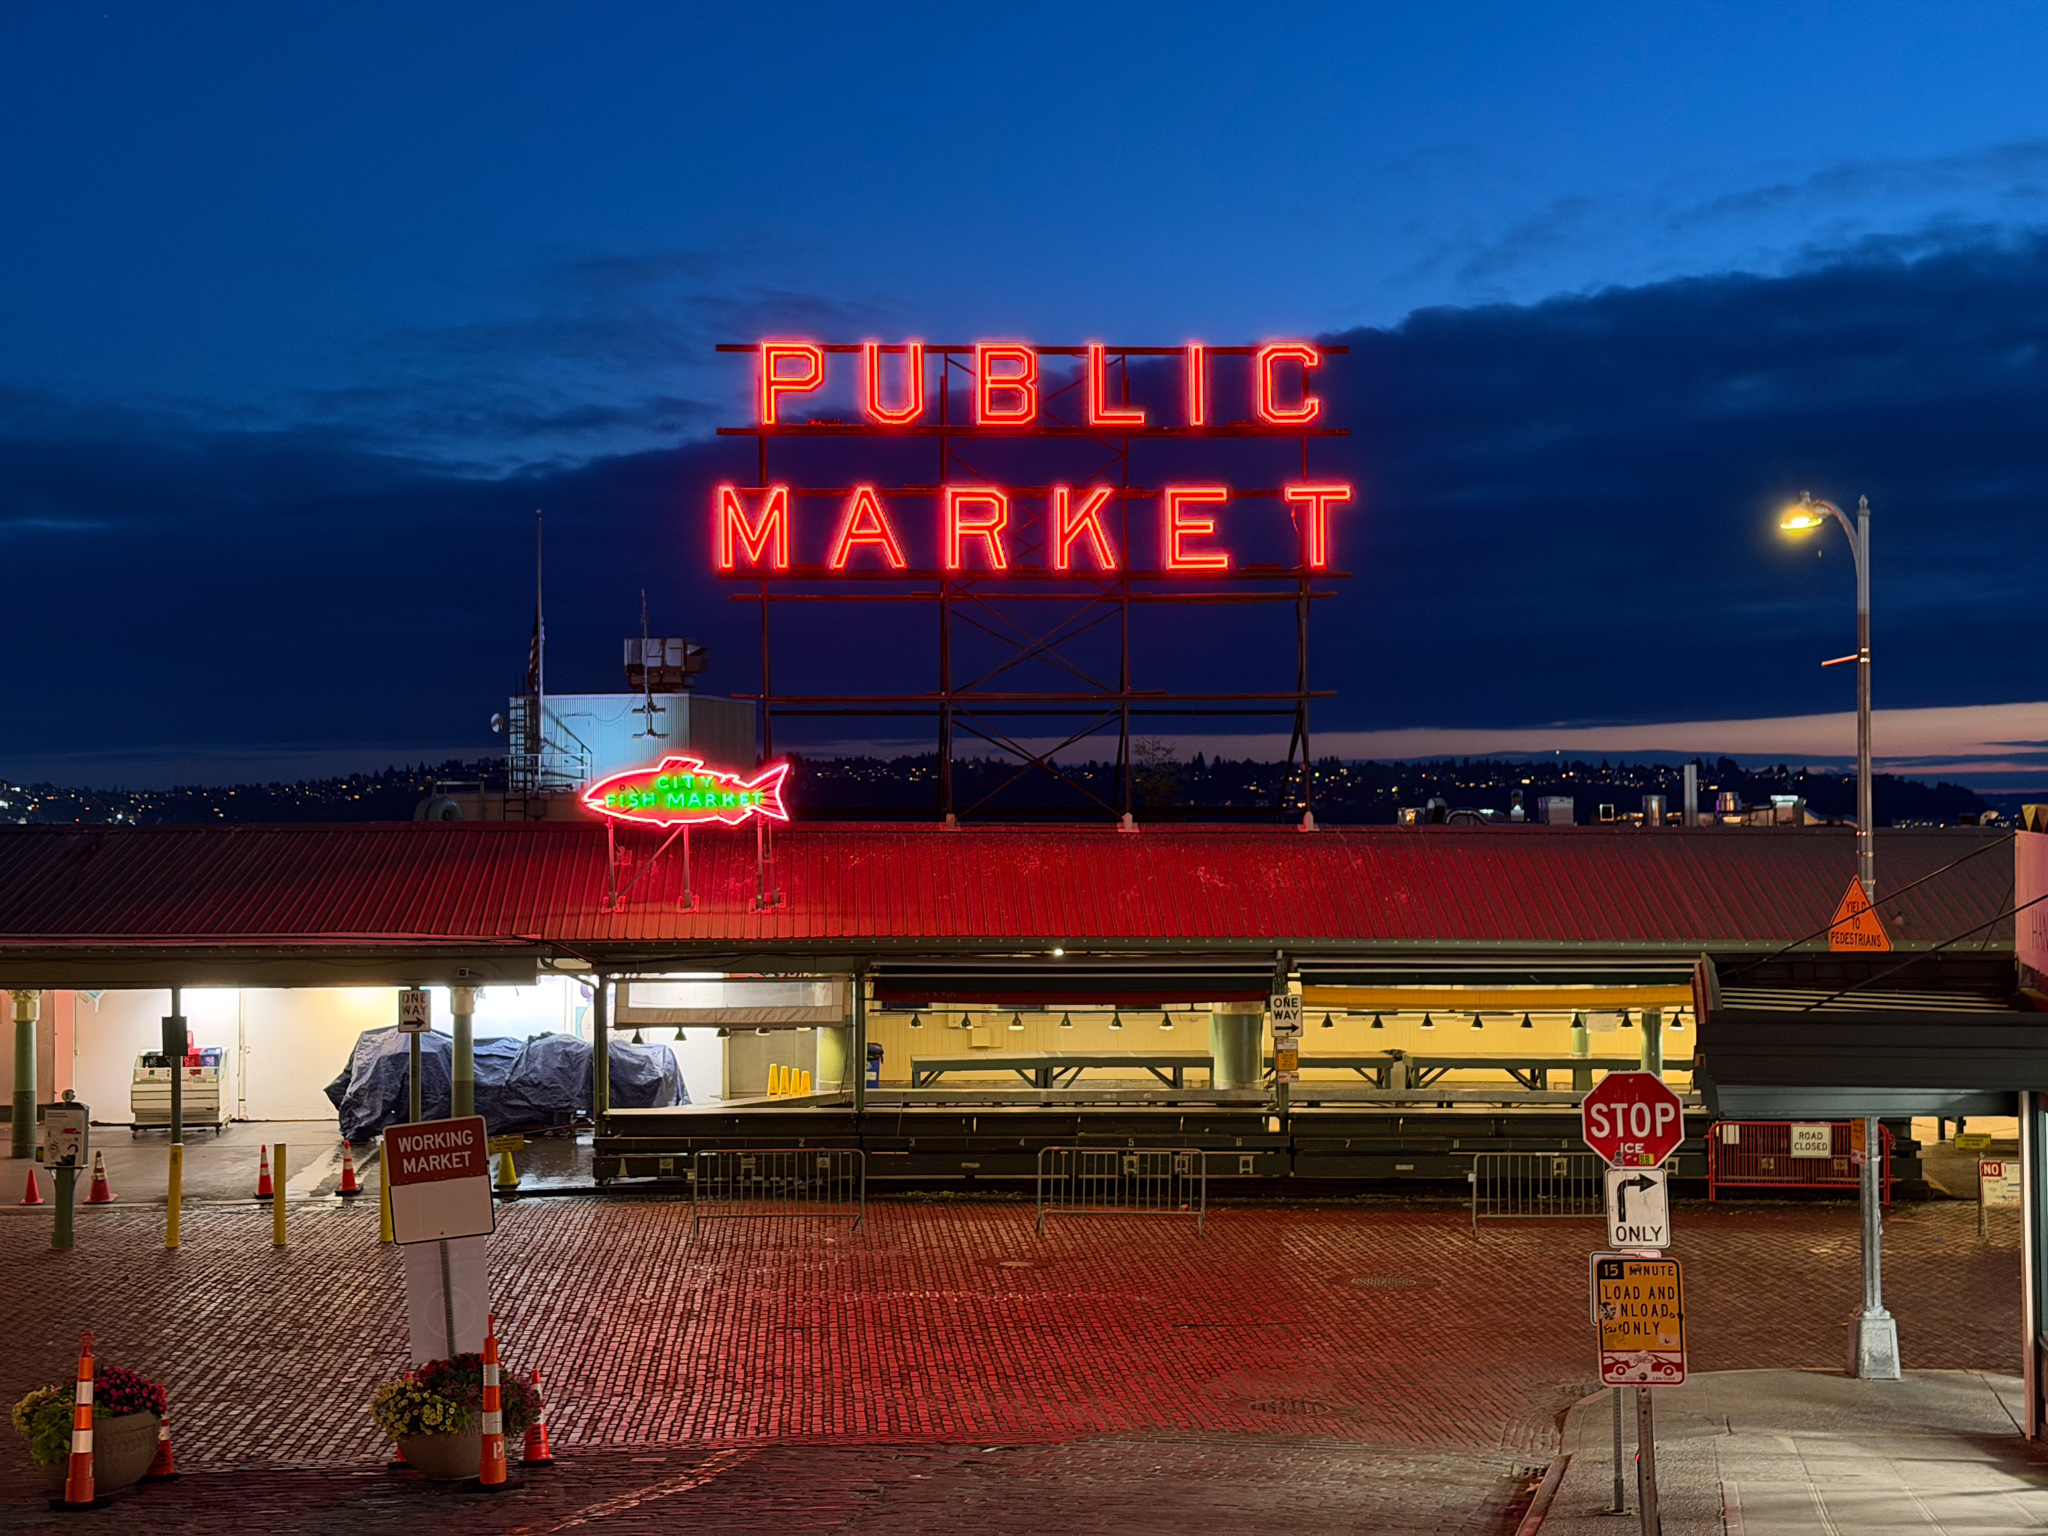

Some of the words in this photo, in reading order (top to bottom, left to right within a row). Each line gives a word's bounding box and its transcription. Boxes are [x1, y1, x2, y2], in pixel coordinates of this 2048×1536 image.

[760, 340, 1321, 426] PUBLIC
[717, 485, 1353, 570] MARKET
[656, 774, 714, 789] CITY
[604, 793, 656, 808] FISH
[666, 792, 765, 808] MARKET
[1846, 900, 1867, 913] YIELD
[1852, 916, 1860, 930] TO
[1830, 931, 1882, 947] PEDESTRIANS
[1273, 997, 1299, 1008] ONE
[402, 1004, 427, 1016] WAY
[1273, 1009, 1299, 1020] WAY
[1590, 1102, 1675, 1138] STOP
[397, 1129, 474, 1153] WORKING
[1799, 1131, 1823, 1140] ROAD
[1620, 1142, 1645, 1154] ICE
[1794, 1142, 1828, 1151] CLOSED
[403, 1151, 471, 1174] MARKET
[1983, 1163, 1999, 1175] NO
[1615, 1225, 1662, 1242] ONLY
[1604, 1264, 1618, 1277] 15
[1604, 1286, 1640, 1300] LOAD
[1648, 1286, 1675, 1300] AND
[1620, 1303, 1669, 1318] NLOAD
[1622, 1321, 1660, 1335] ONLY
